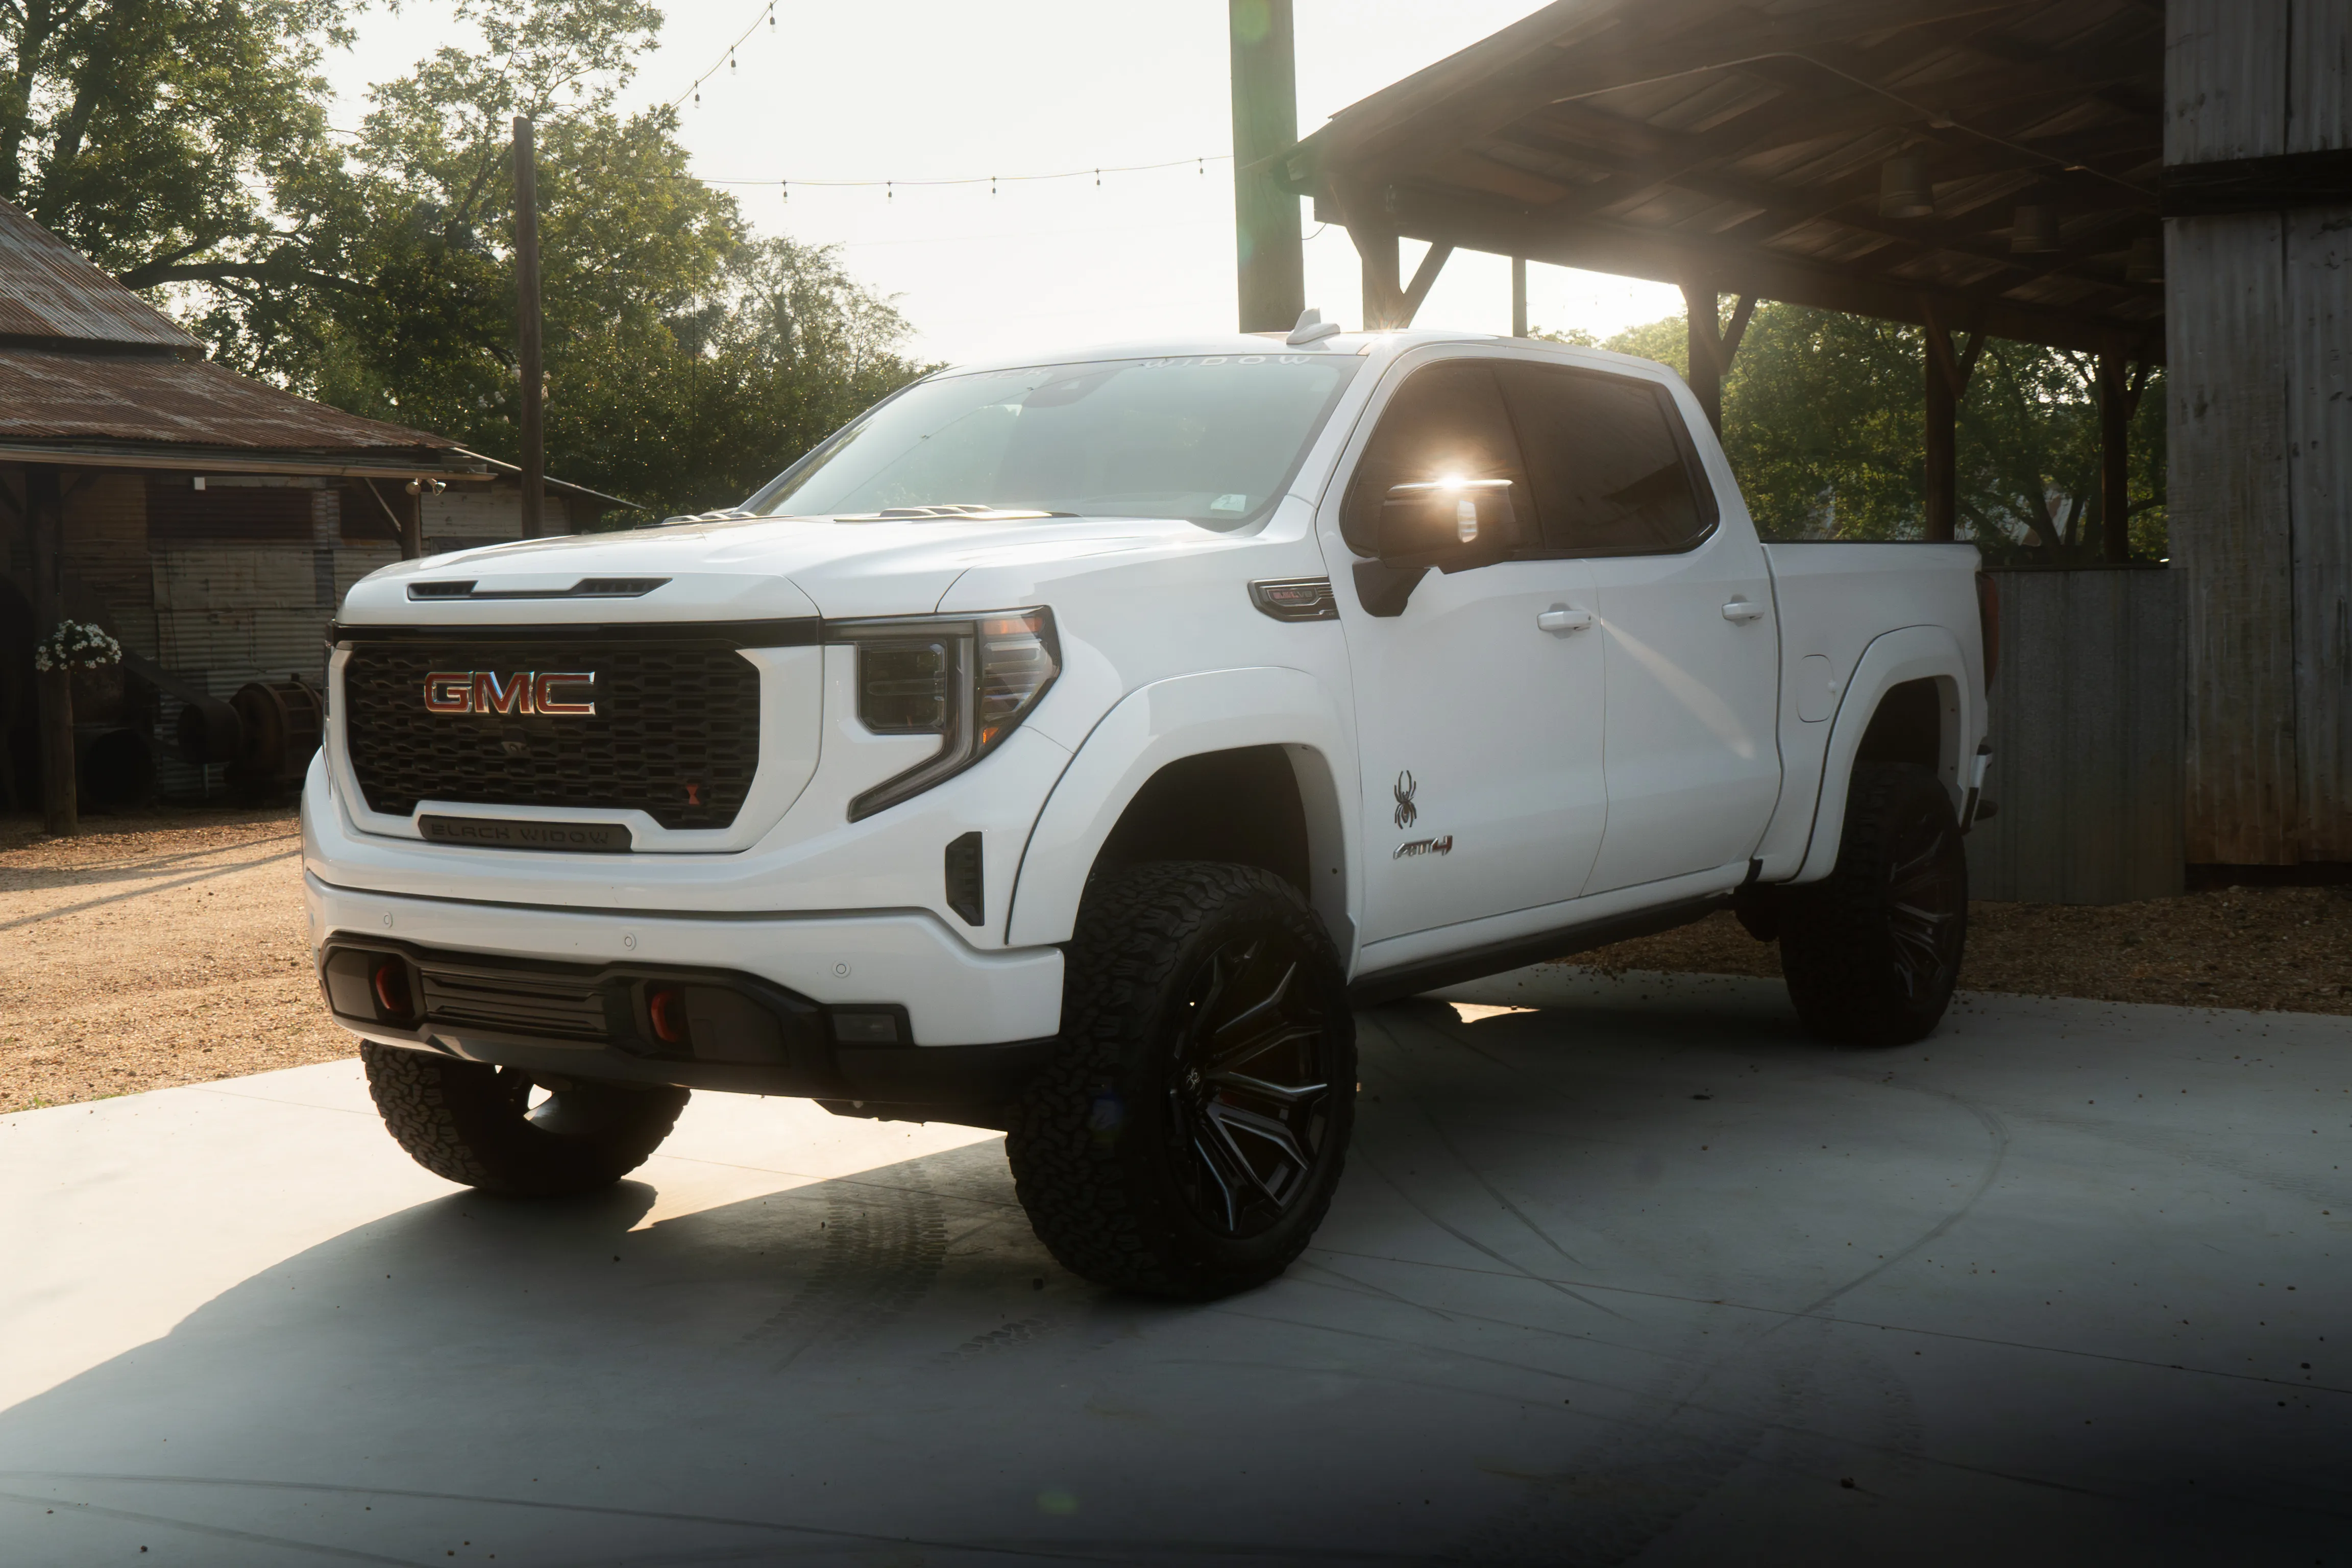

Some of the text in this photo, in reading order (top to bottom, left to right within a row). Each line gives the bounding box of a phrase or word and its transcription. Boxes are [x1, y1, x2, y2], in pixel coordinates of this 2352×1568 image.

[1145, 356, 1312, 369] WIDOW
[424, 671, 596, 715] GMC
[431, 823, 609, 845] BLACK WIDOW
[1393, 835, 1453, 860] AT4
